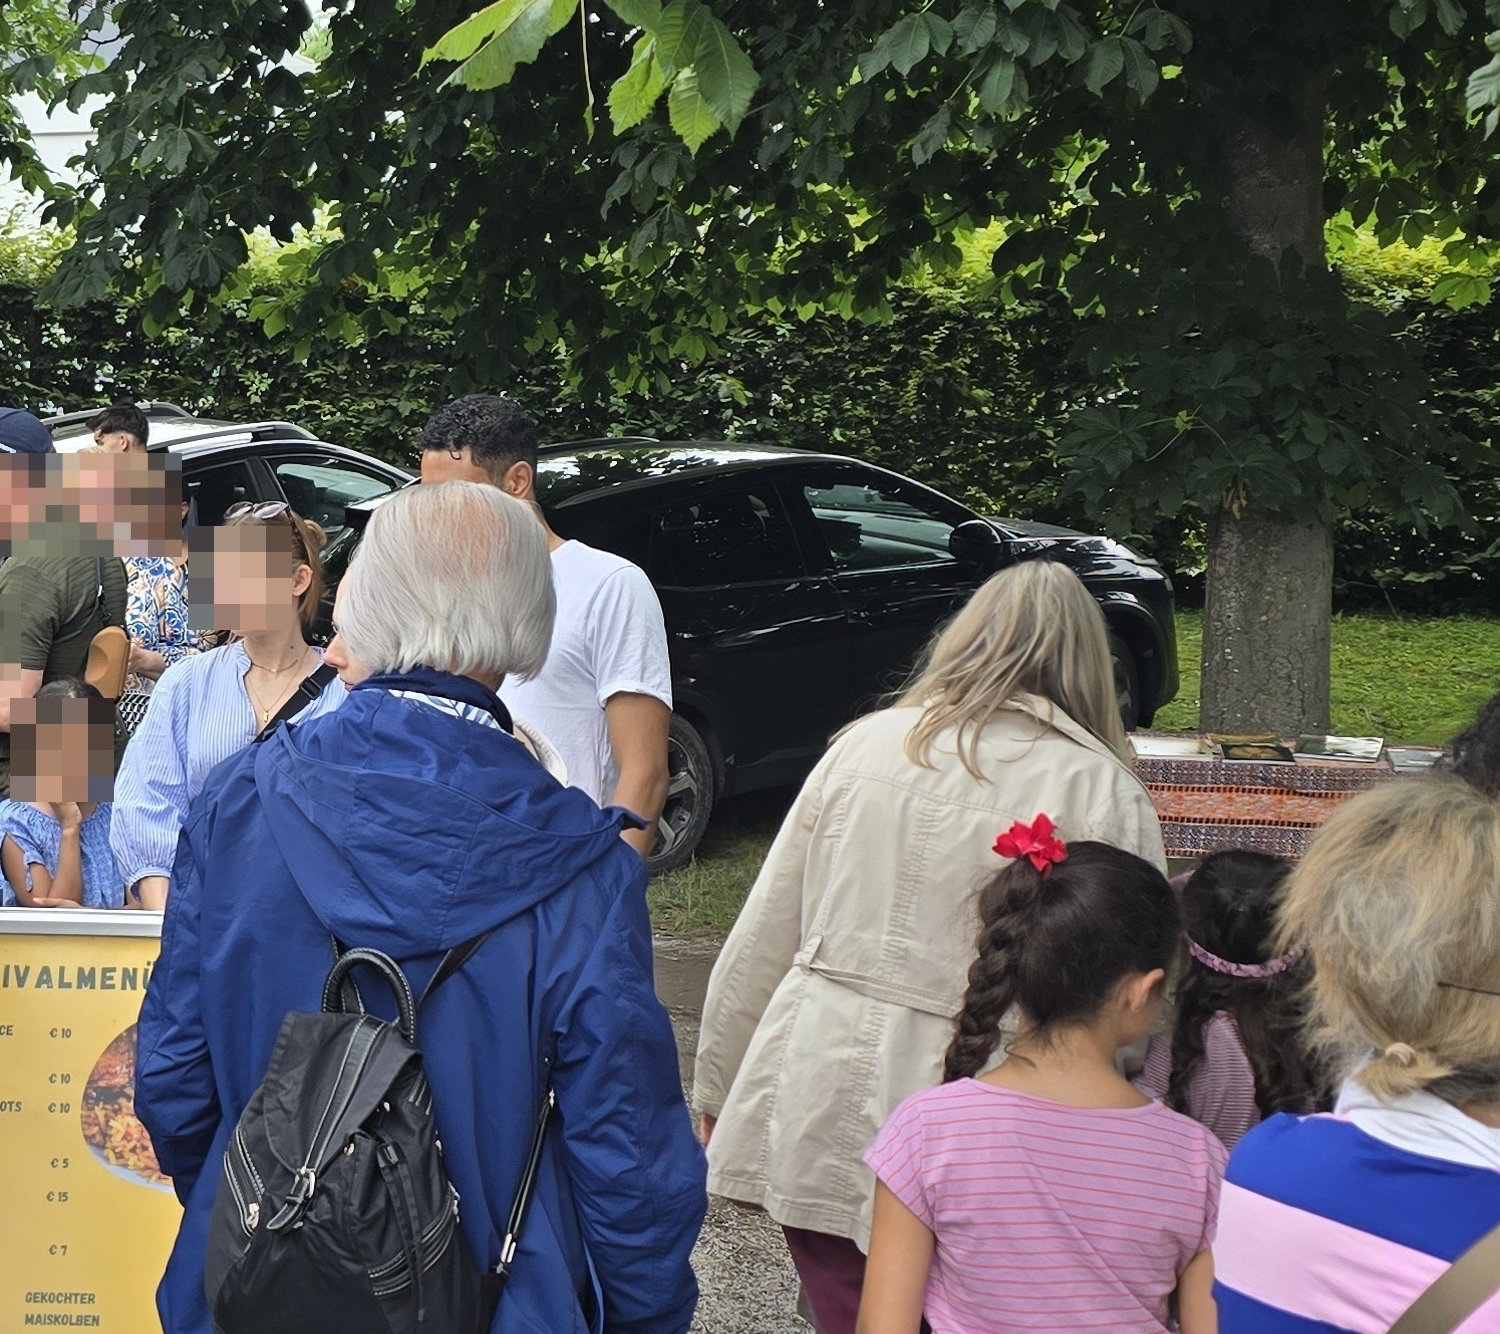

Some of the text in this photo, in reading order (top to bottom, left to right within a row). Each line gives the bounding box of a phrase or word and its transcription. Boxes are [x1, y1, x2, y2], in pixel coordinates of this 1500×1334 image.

[62, 1028, 71, 1038] 10
[61, 1073, 70, 1084] 10
[60, 1103, 70, 1113] 10
[62, 1158, 69, 1168] 5
[58, 1191, 68, 1202] 15
[61, 1245, 67, 1255] 7
[25, 1292, 95, 1304] GEKOCHTER
[25, 1313, 99, 1326] MAISKOLBEN
